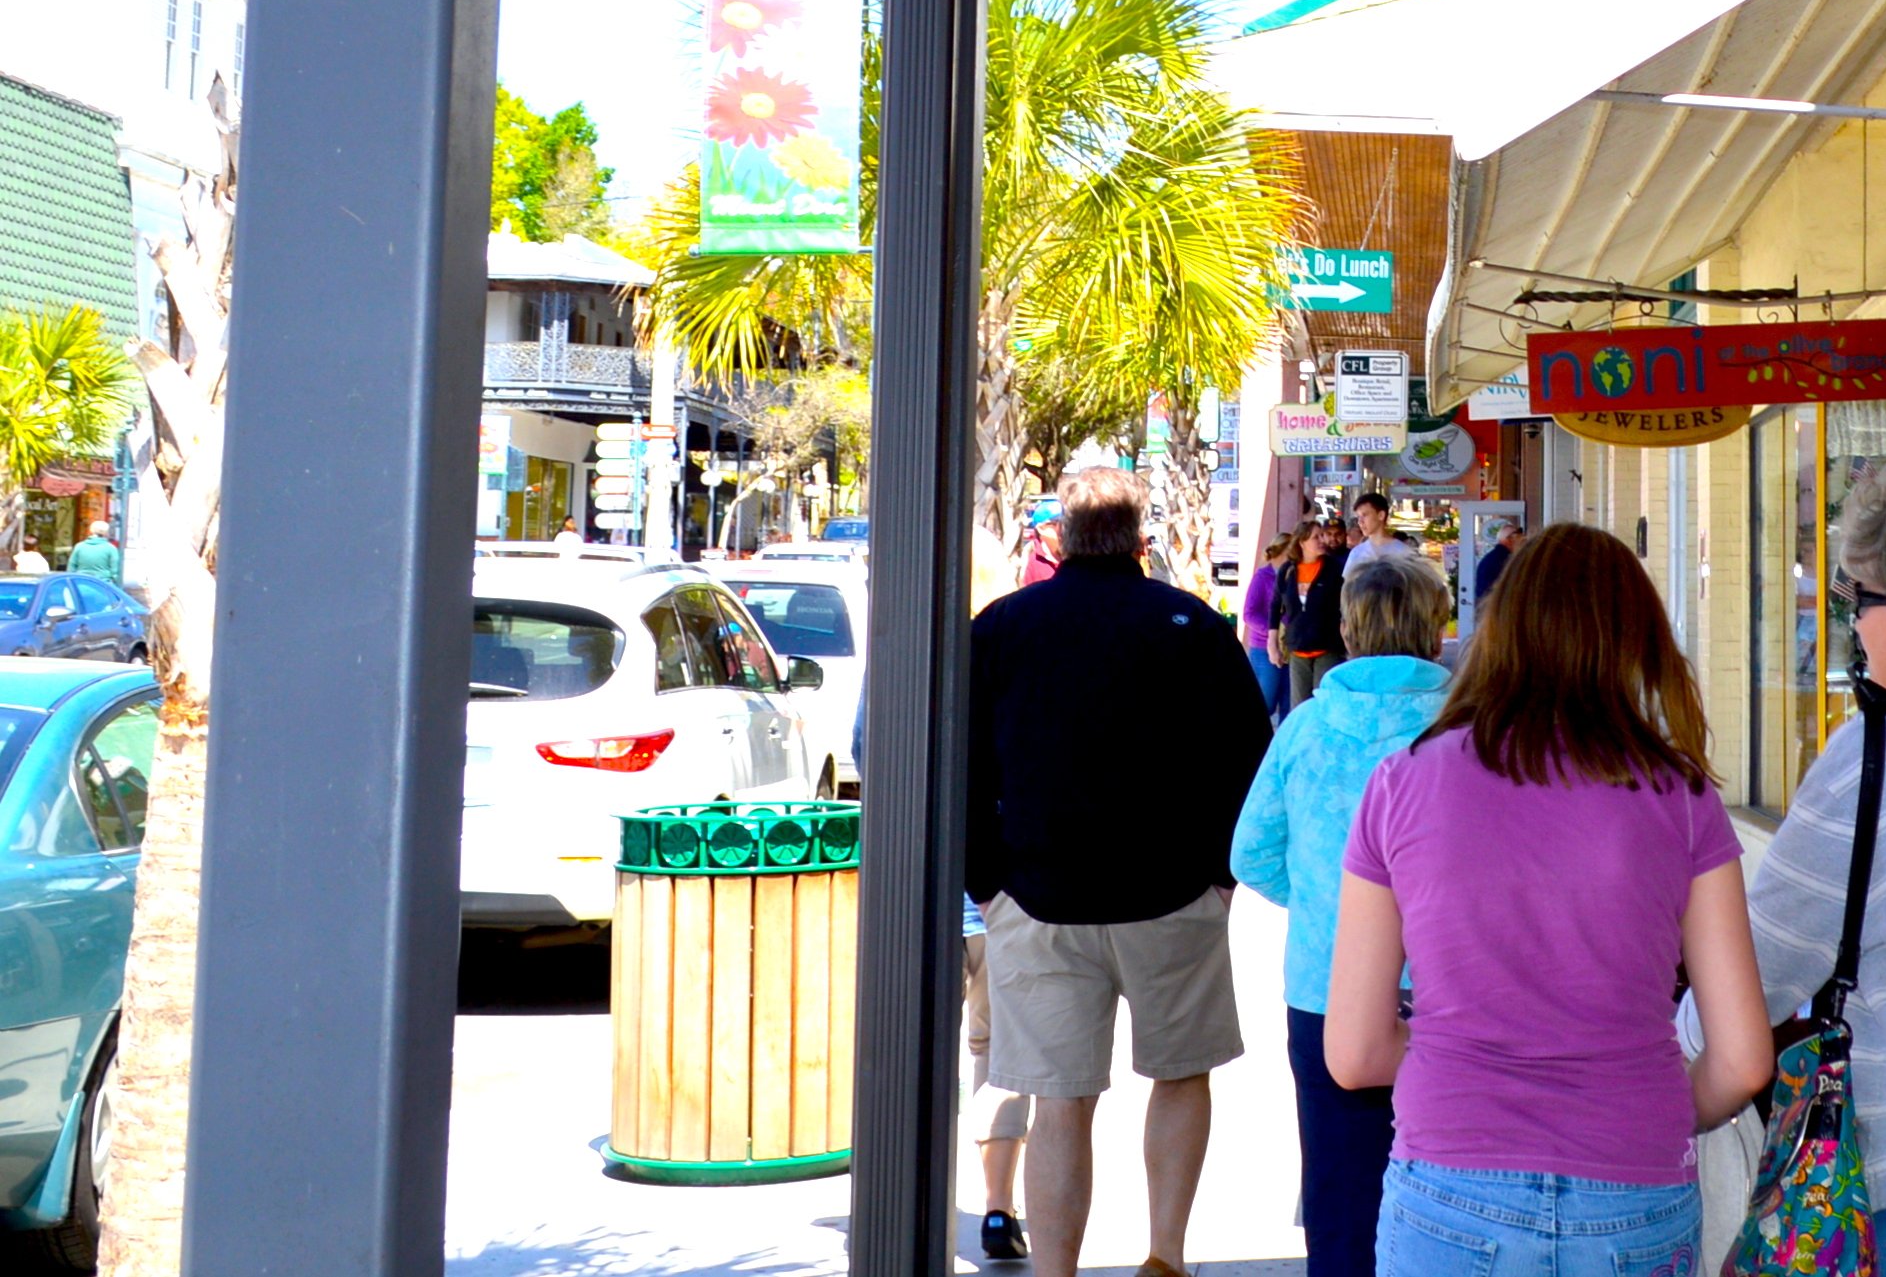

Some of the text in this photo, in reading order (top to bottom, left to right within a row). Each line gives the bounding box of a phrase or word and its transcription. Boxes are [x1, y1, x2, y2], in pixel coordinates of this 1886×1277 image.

[1314, 252, 1335, 276] Do
[1340, 253, 1390, 278] Lunch
[1341, 360, 1368, 372] CFL
[1540, 327, 1705, 400] noni
[1276, 410, 1327, 430] home
[1283, 436, 1393, 453] TREASURES
